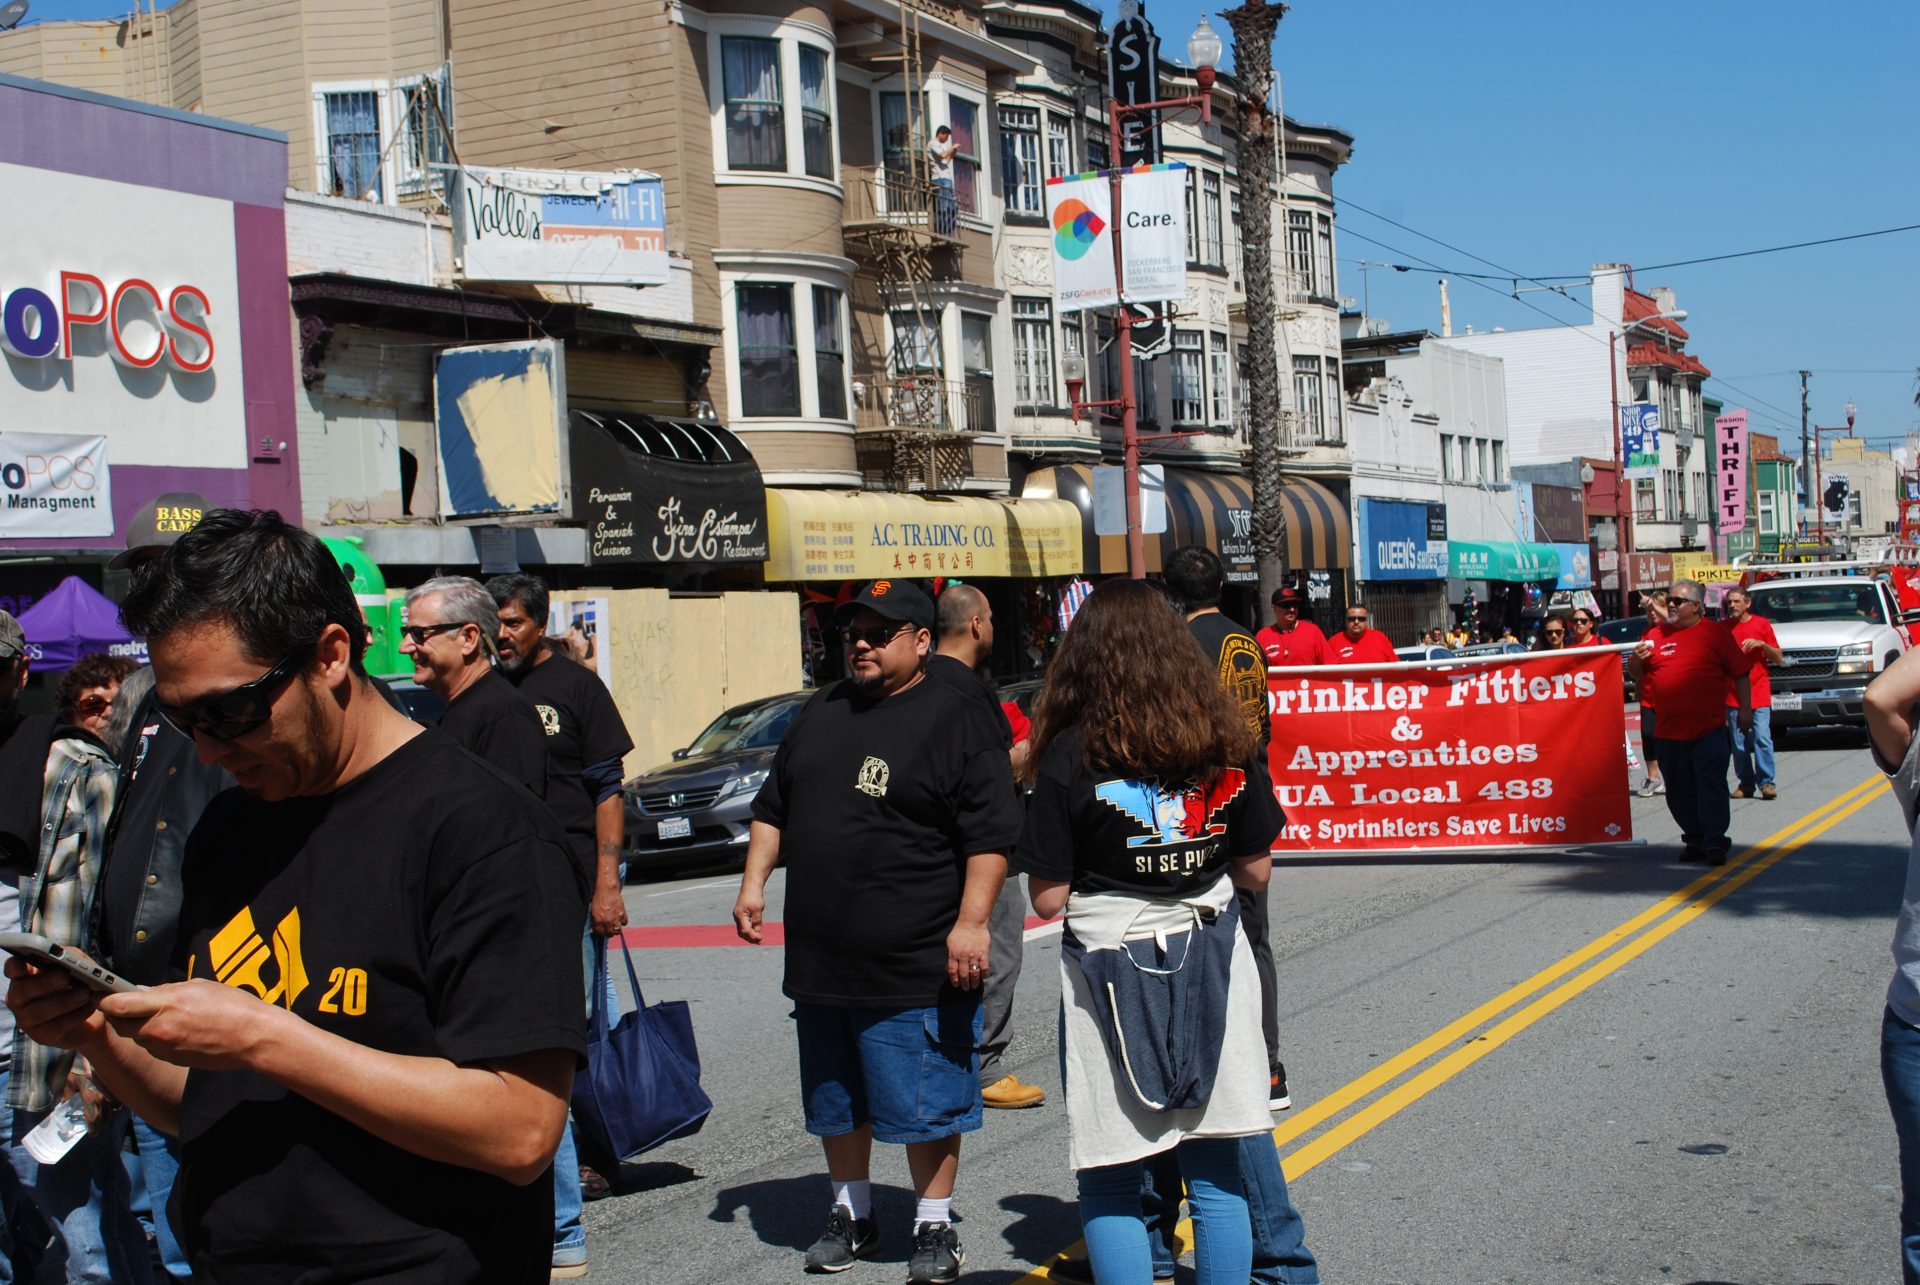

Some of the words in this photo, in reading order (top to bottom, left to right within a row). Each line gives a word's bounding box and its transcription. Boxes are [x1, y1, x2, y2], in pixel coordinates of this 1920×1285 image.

[1126, 211, 1176, 228] Care.
[1127, 268, 1142, 276] SAN
[1143, 265, 1182, 275] FRANCISCO
[0, 455, 97, 491] oPCS
[1721, 426, 1740, 517] THRIFT
[8, 493, 96, 512] Managment
[589, 487, 632, 504] Peruvian
[156, 506, 201, 521] BASS
[605, 505, 617, 521] &
[594, 522, 634, 544] Spanish
[870, 522, 898, 547] A.C.
[900, 523, 968, 547] TRADING
[973, 525, 995, 548] CO.
[593, 541, 632, 557] Cuisine
[722, 539, 767, 558] Restaurant
[1378, 537, 1416, 570] QUEEN'S
[1417, 550, 1438, 570] SHOES
[1446, 668, 1596, 707] Fitters
[1391, 716, 1423, 741] &
[1287, 739, 1538, 775] Apprentices
[1275, 785, 1335, 807] UA
[1351, 780, 1461, 805] Local
[1478, 777, 1553, 800] 483
[1281, 823, 1312, 840] ire
[1317, 818, 1440, 842] Sprinklers
[1446, 815, 1502, 835] Save
[1509, 813, 1566, 834] Lives
[1136, 855, 1152, 873] SI
[1159, 852, 1179, 873] SE
[318, 966, 368, 1016] 20
